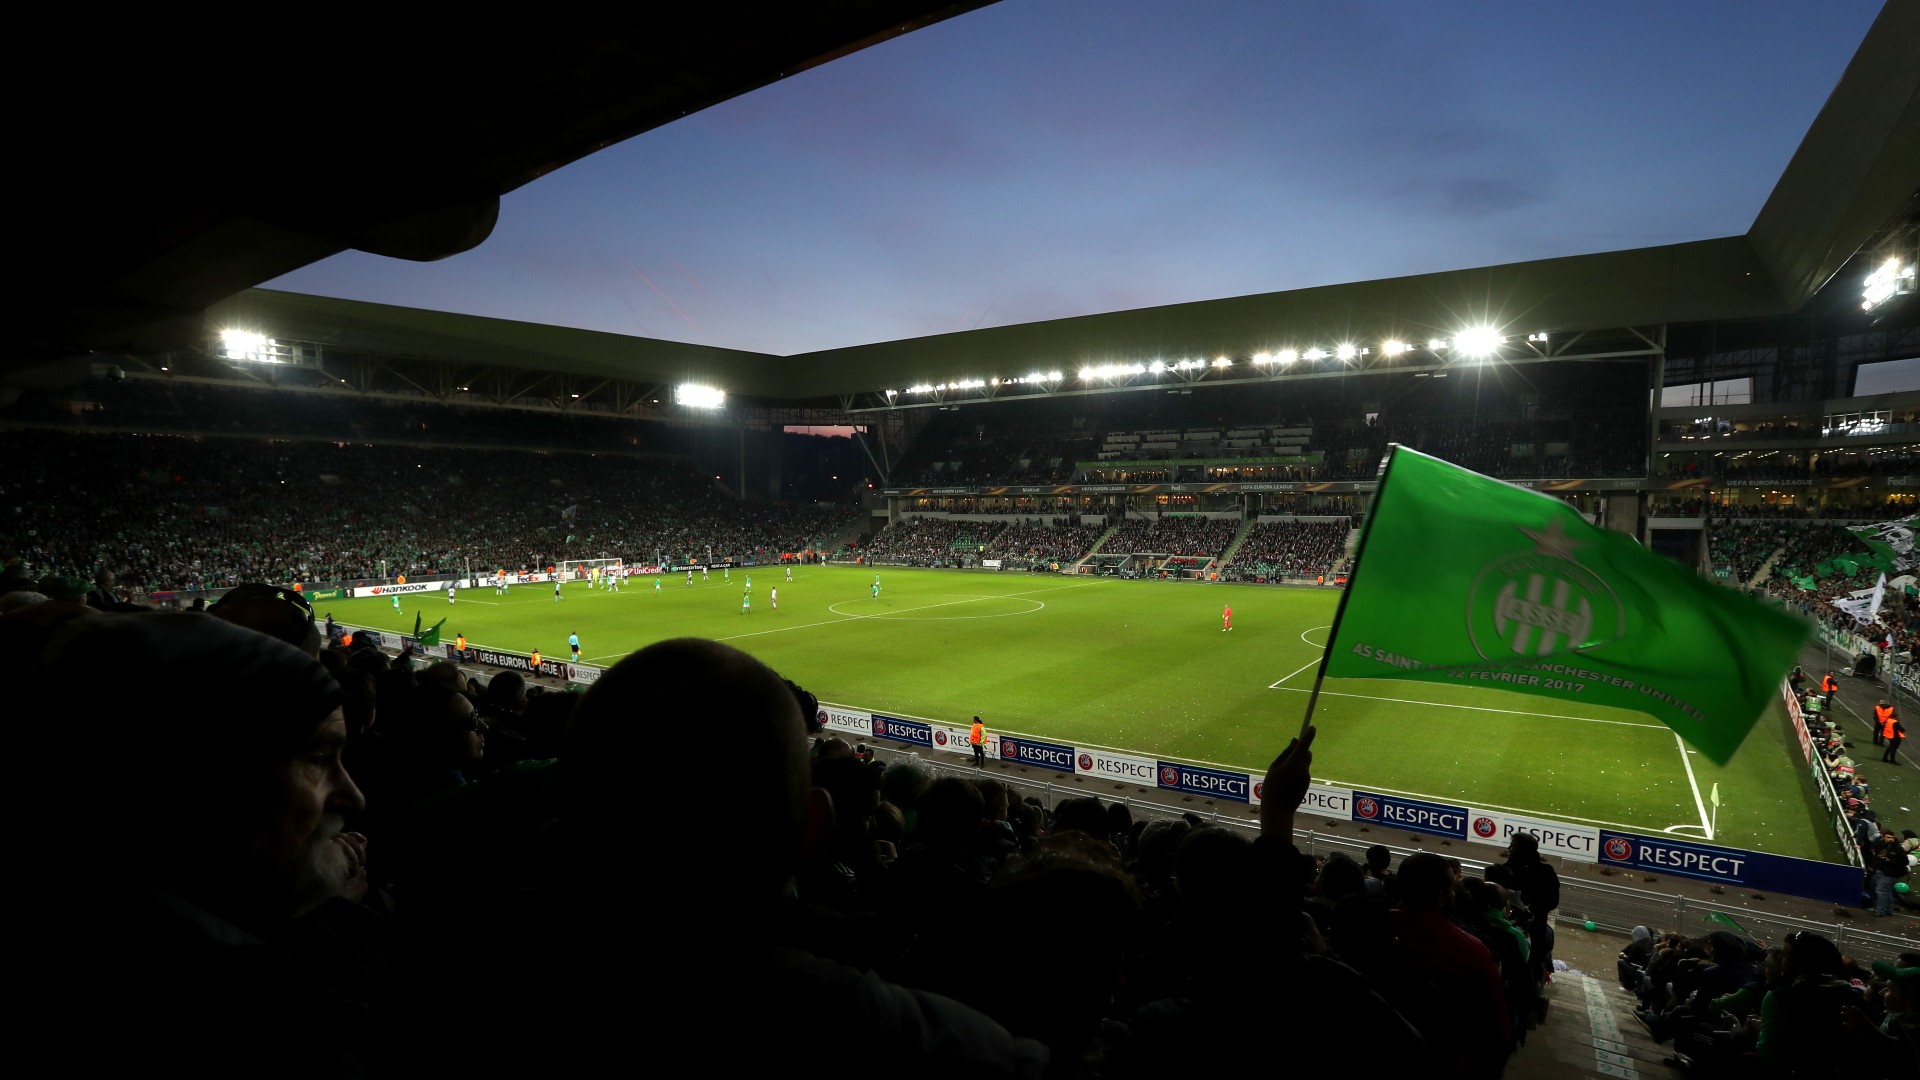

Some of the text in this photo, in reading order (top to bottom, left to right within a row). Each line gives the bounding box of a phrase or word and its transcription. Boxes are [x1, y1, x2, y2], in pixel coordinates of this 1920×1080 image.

[517, 574, 538, 582] FedEx
[480, 653, 499, 666] UEFA
[500, 656, 528, 671] EUROPA
[1352, 642, 1706, 722] AS SAINT ANCHESTER UNITED
[1544, 678, 1584, 693] 2017
[831, 714, 870, 730] RESPECT
[888, 724, 930, 741] RESPECT
[1020, 746, 1072, 766] RESPECT
[1097, 759, 1154, 778] RESPECT
[1182, 772, 1247, 795] RESPECT
[1384, 804, 1464, 831] RESPECT
[1639, 845, 1744, 876] RESPECT
